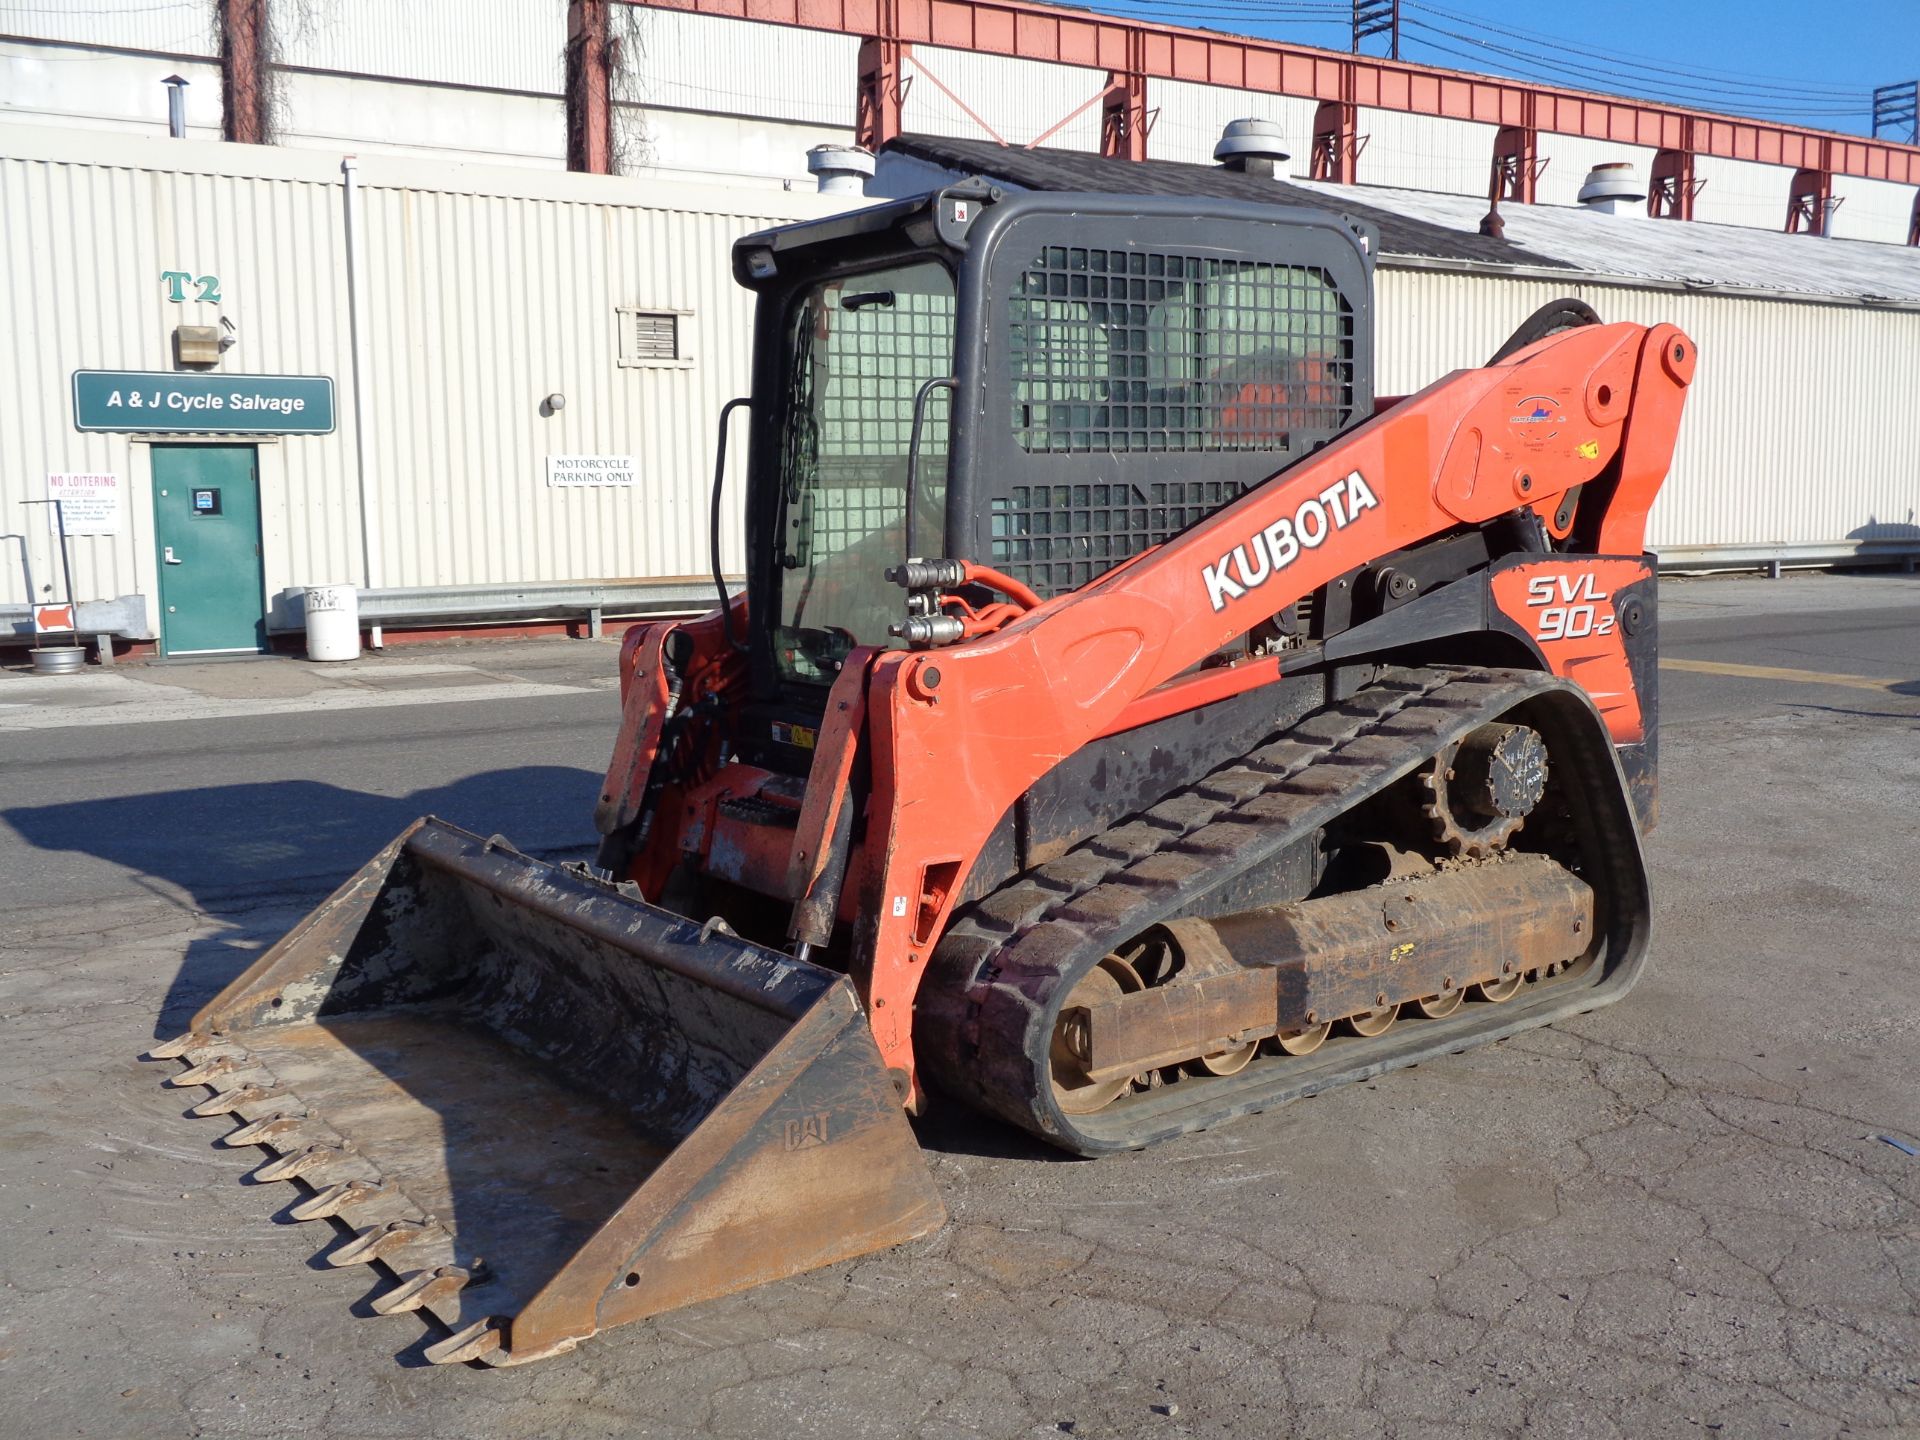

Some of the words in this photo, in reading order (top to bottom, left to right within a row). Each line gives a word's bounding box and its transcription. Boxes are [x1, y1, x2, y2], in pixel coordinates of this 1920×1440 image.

[107, 390, 122, 407] A
[128, 391, 142, 408] &
[148, 392, 161, 409] J
[167, 392, 223, 413] Cycle
[229, 393, 305, 415] Salvage
[553, 472, 603, 482] PARKING
[606, 472, 634, 482] ONLY
[556, 459, 630, 469] MOTORCYCLE
[50, 475, 64, 487] NO
[68, 475, 117, 487] LOITERING
[1201, 470, 1379, 613] KUBOTA
[1526, 573, 1608, 607] SVL
[1536, 605, 1615, 642] 90-2
[784, 1111, 833, 1152] CAT
